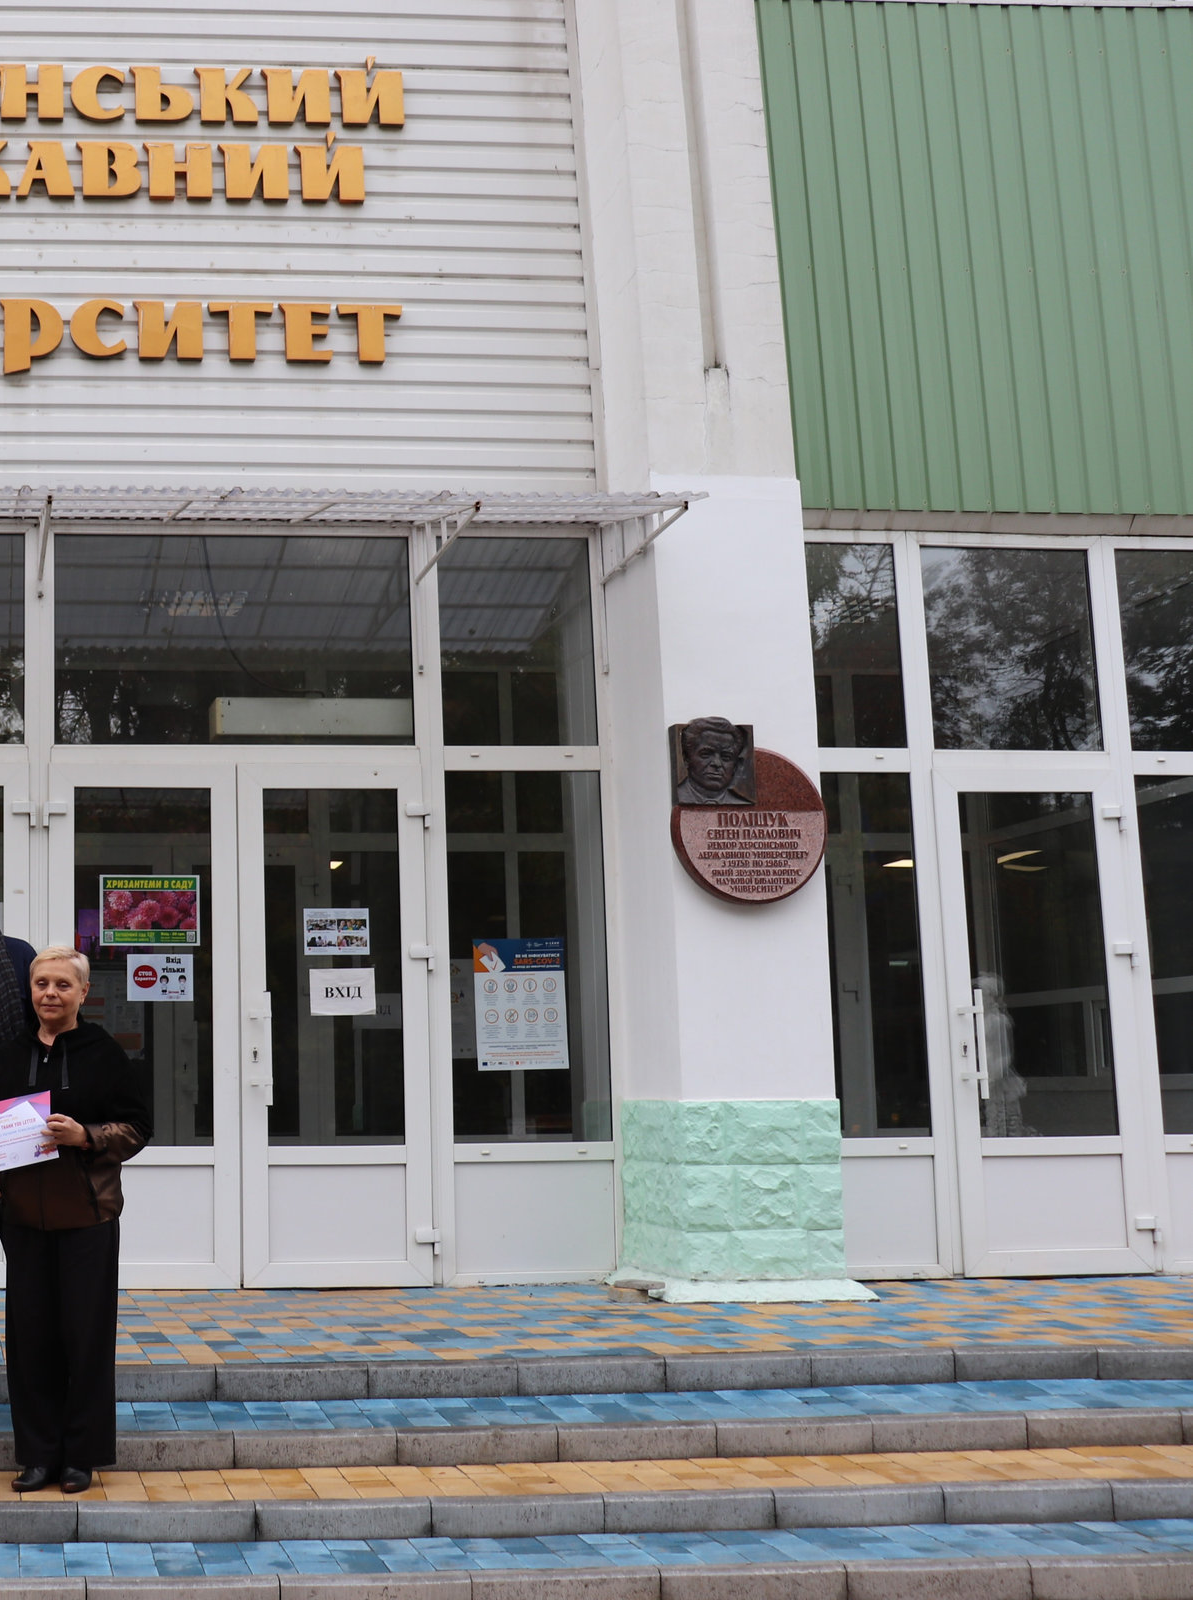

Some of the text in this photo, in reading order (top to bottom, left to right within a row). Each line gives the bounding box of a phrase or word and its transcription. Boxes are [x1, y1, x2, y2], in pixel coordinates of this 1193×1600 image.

[717, 812, 789, 828] ПОЛІЩУК
[706, 828, 801, 840] ЄВГЕН ПАВЛОВИЧ
[708, 841, 799, 850] РЕКТОР ХЕРСОНСЬКОГО
[752, 851, 809, 859] УНІВЕРСИТЕТУ
[712, 868, 734, 877] ЯКИЙ
[106, 880, 194, 889] ХРИЗАНТЕМИ В САДУ
[716, 877, 797, 885] НАУКОВОЇ БІБЛІОТЕКИ
[730, 885, 784, 893] УНІВЕРСИТЕТУ
[166, 956, 182, 964] Вхід
[325, 986, 362, 1000] ВХІД
